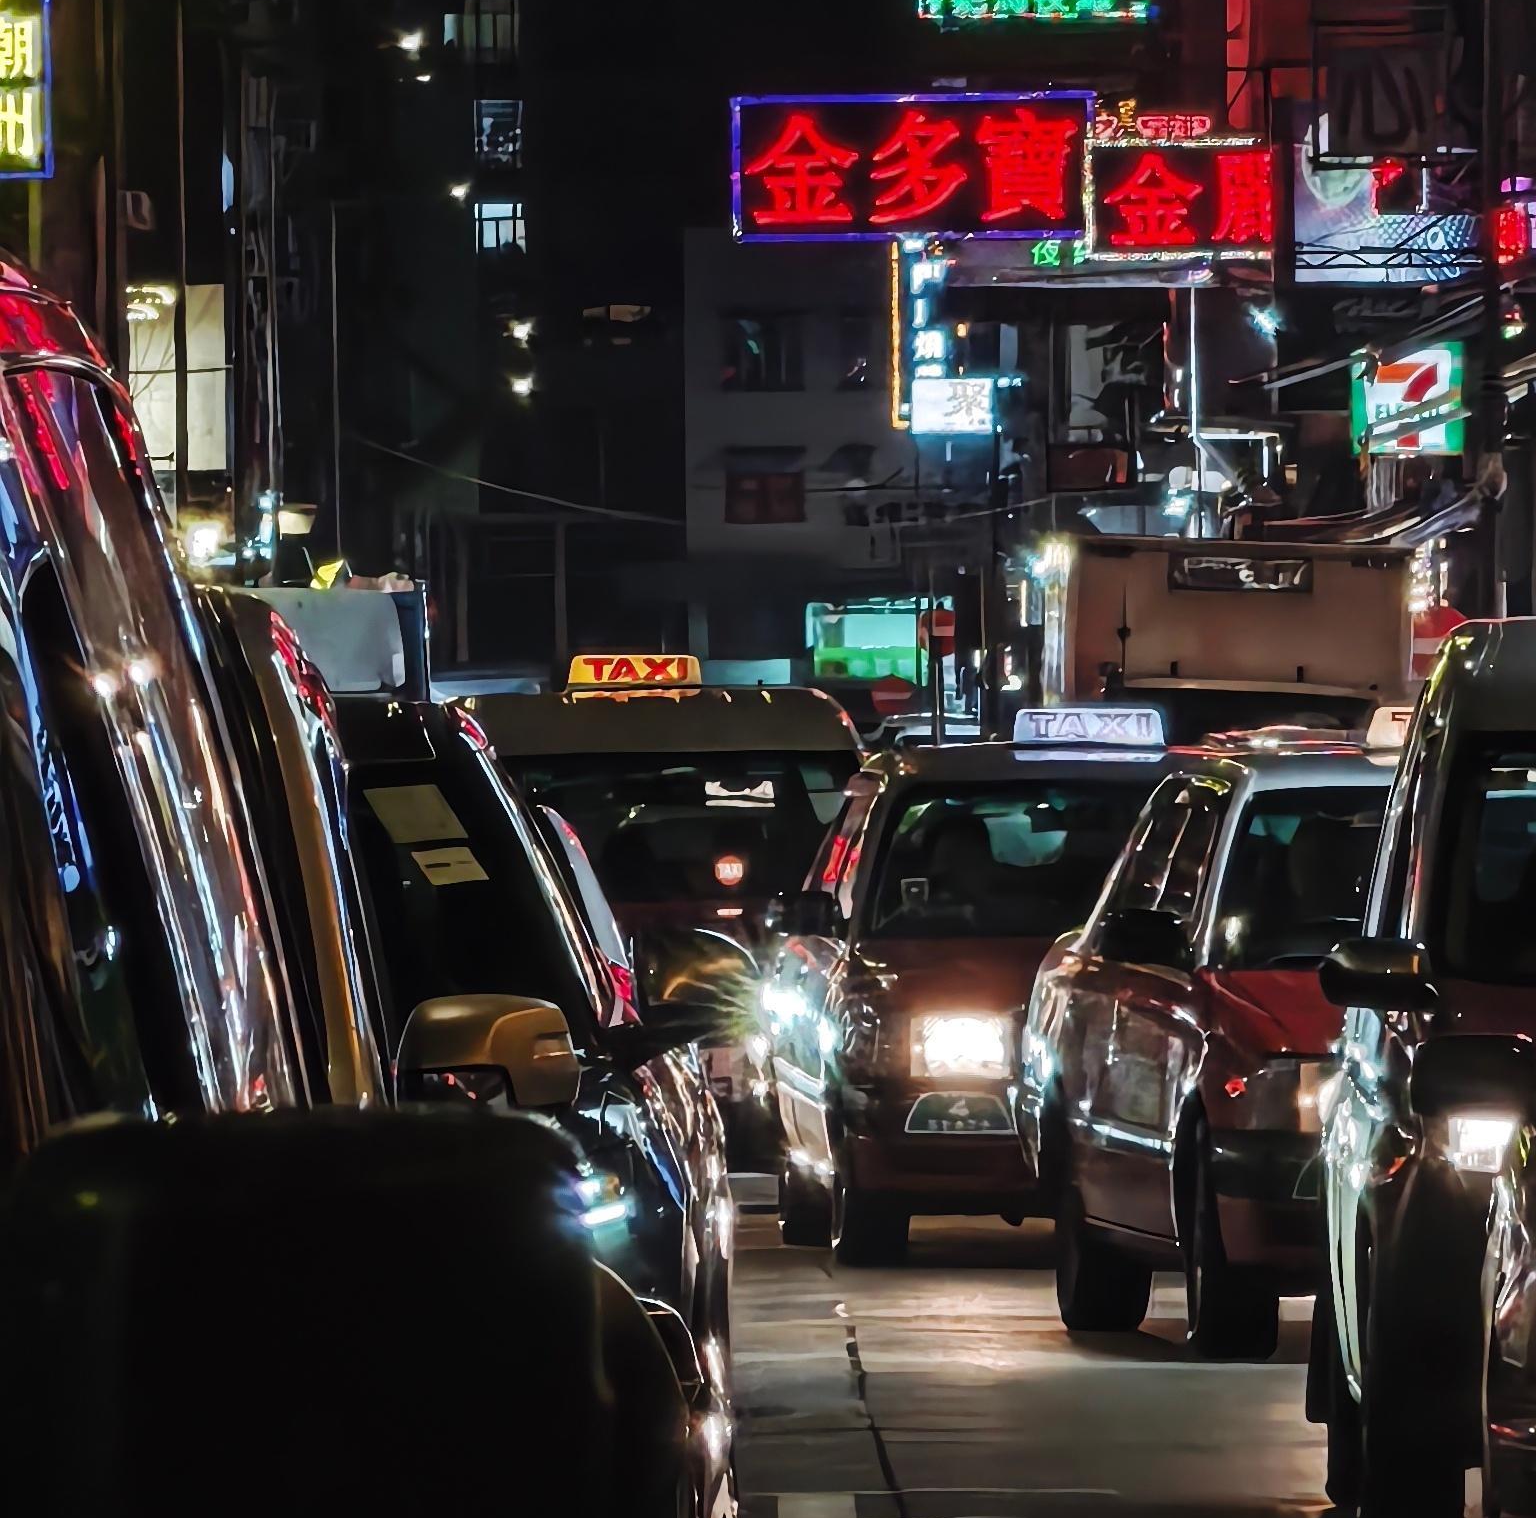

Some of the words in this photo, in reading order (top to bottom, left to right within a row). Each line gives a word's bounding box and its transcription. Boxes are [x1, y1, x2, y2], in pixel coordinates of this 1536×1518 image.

[746, 108, 1078, 225] 金多寶
[582, 657, 688, 683] TAXI
[1028, 711, 1155, 740] TAXI
